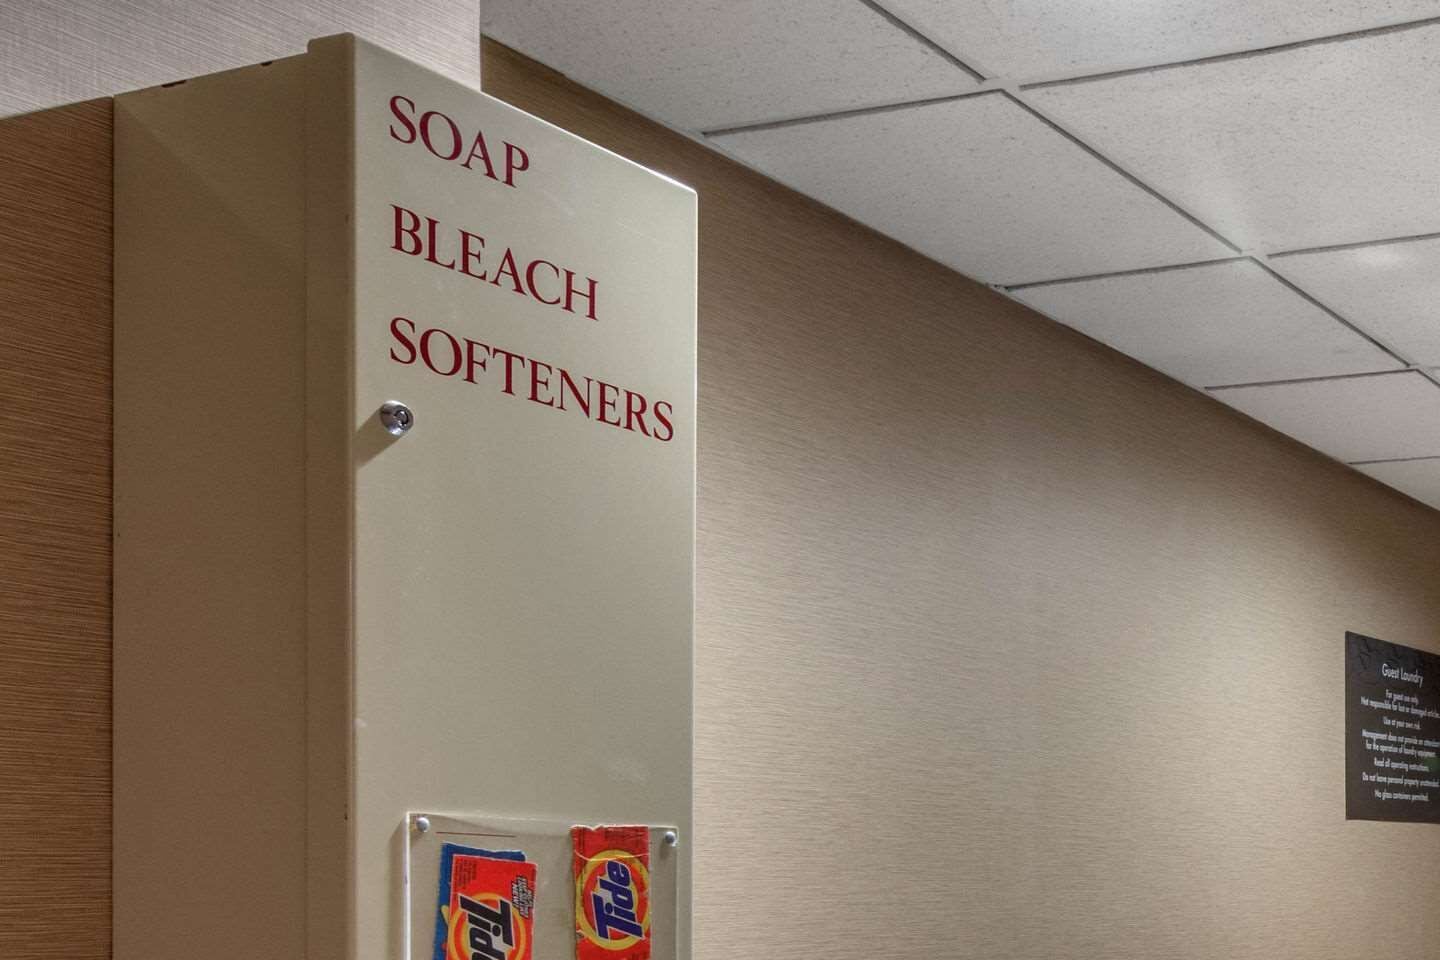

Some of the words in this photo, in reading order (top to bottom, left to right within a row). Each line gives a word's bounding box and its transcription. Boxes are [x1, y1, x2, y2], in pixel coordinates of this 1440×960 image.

[389, 95, 530, 188] SOAP
[389, 203, 599, 321] BLEACH
[389, 316, 675, 442] SOFTENERS
[1382, 663, 1399, 681] Guest
[1401, 667, 1424, 688] Laundry
[592, 860, 645, 940] Tide
